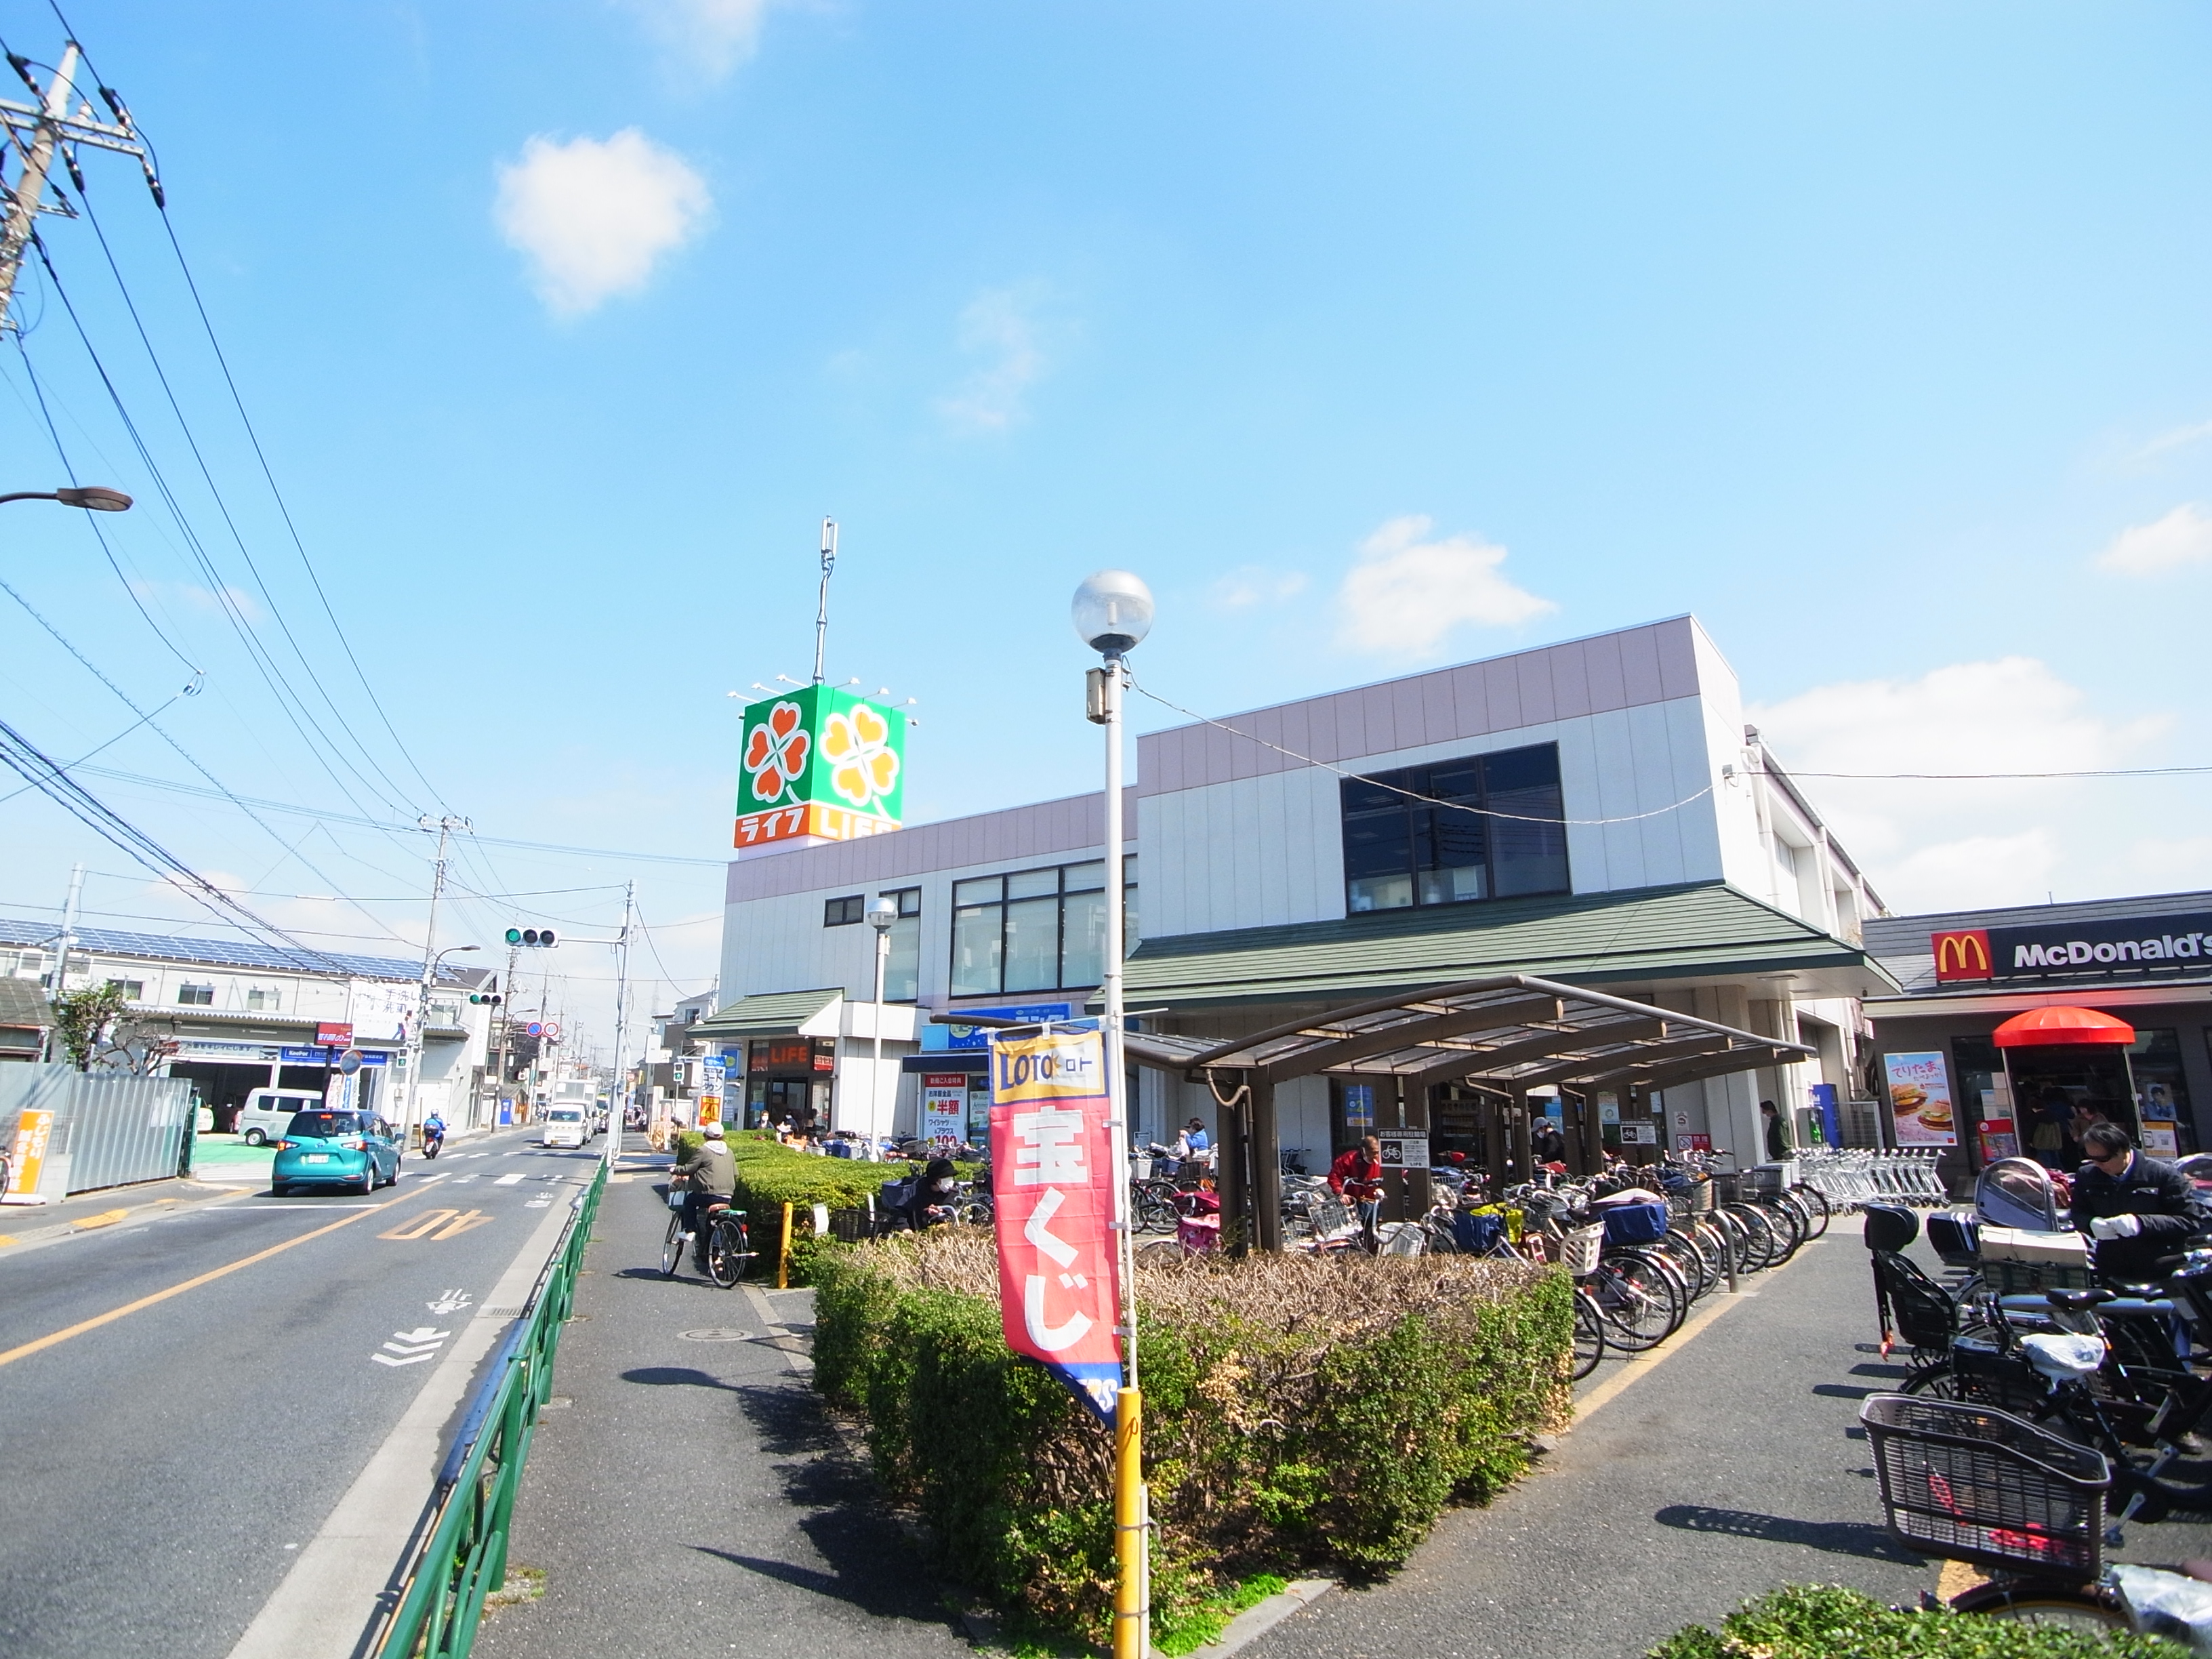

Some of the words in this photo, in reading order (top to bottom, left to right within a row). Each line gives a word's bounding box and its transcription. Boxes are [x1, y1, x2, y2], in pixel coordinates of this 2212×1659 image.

[741, 807, 804, 842] ライフ
[771, 1046, 808, 1063] LIFE
[703, 1074, 723, 1082] コート
[1000, 1053, 1054, 1090] LOTO
[703, 1083, 722, 1092] ダウン
[937, 1099, 959, 1115] 半額
[1014, 1105, 1092, 1351] 宝くじ
